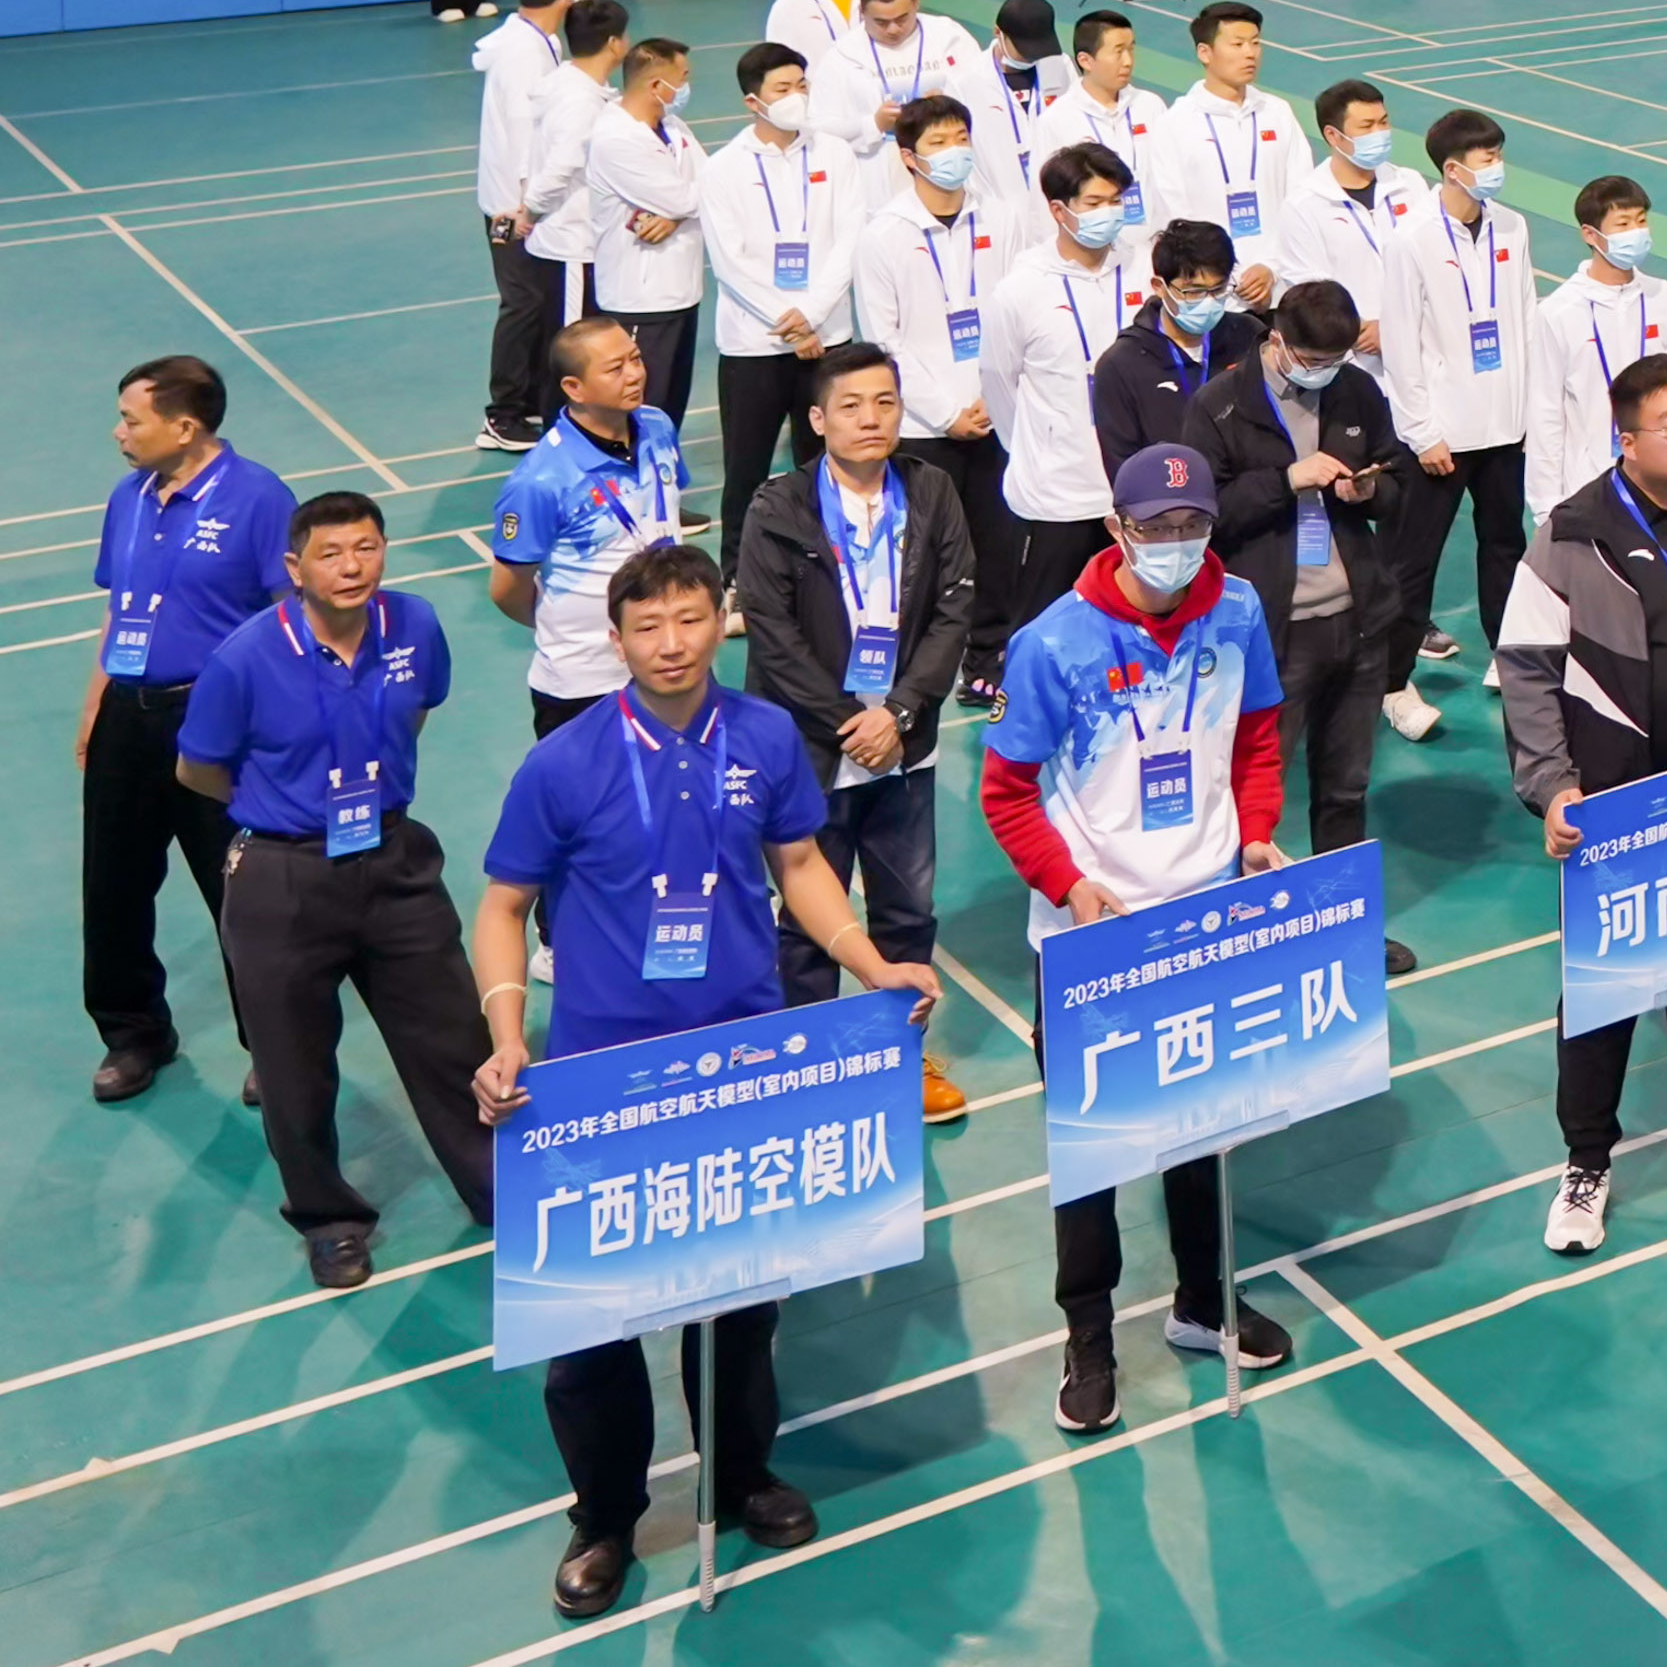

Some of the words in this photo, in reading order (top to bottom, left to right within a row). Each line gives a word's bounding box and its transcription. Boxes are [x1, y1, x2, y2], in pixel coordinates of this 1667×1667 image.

[1164, 456, 1190, 489] B
[196, 529, 219, 540] ASFC
[116, 630, 147, 646] 运动员
[388, 658, 410, 671] ASFC
[859, 649, 887, 666] 领队
[1146, 777, 1188, 799] 运动员
[337, 804, 372, 825] 教练
[655, 923, 704, 943] 运动员
[1063, 897, 1366, 1009] 2023年全国航空航天模型(室内项目)锦标赛
[1080, 960, 1358, 1116] 广西三队
[521, 1046, 901, 1154] 2023年全国航空航天模型(室内项目)锦标赛
[532, 1112, 896, 1273] 广西海陆空模队
